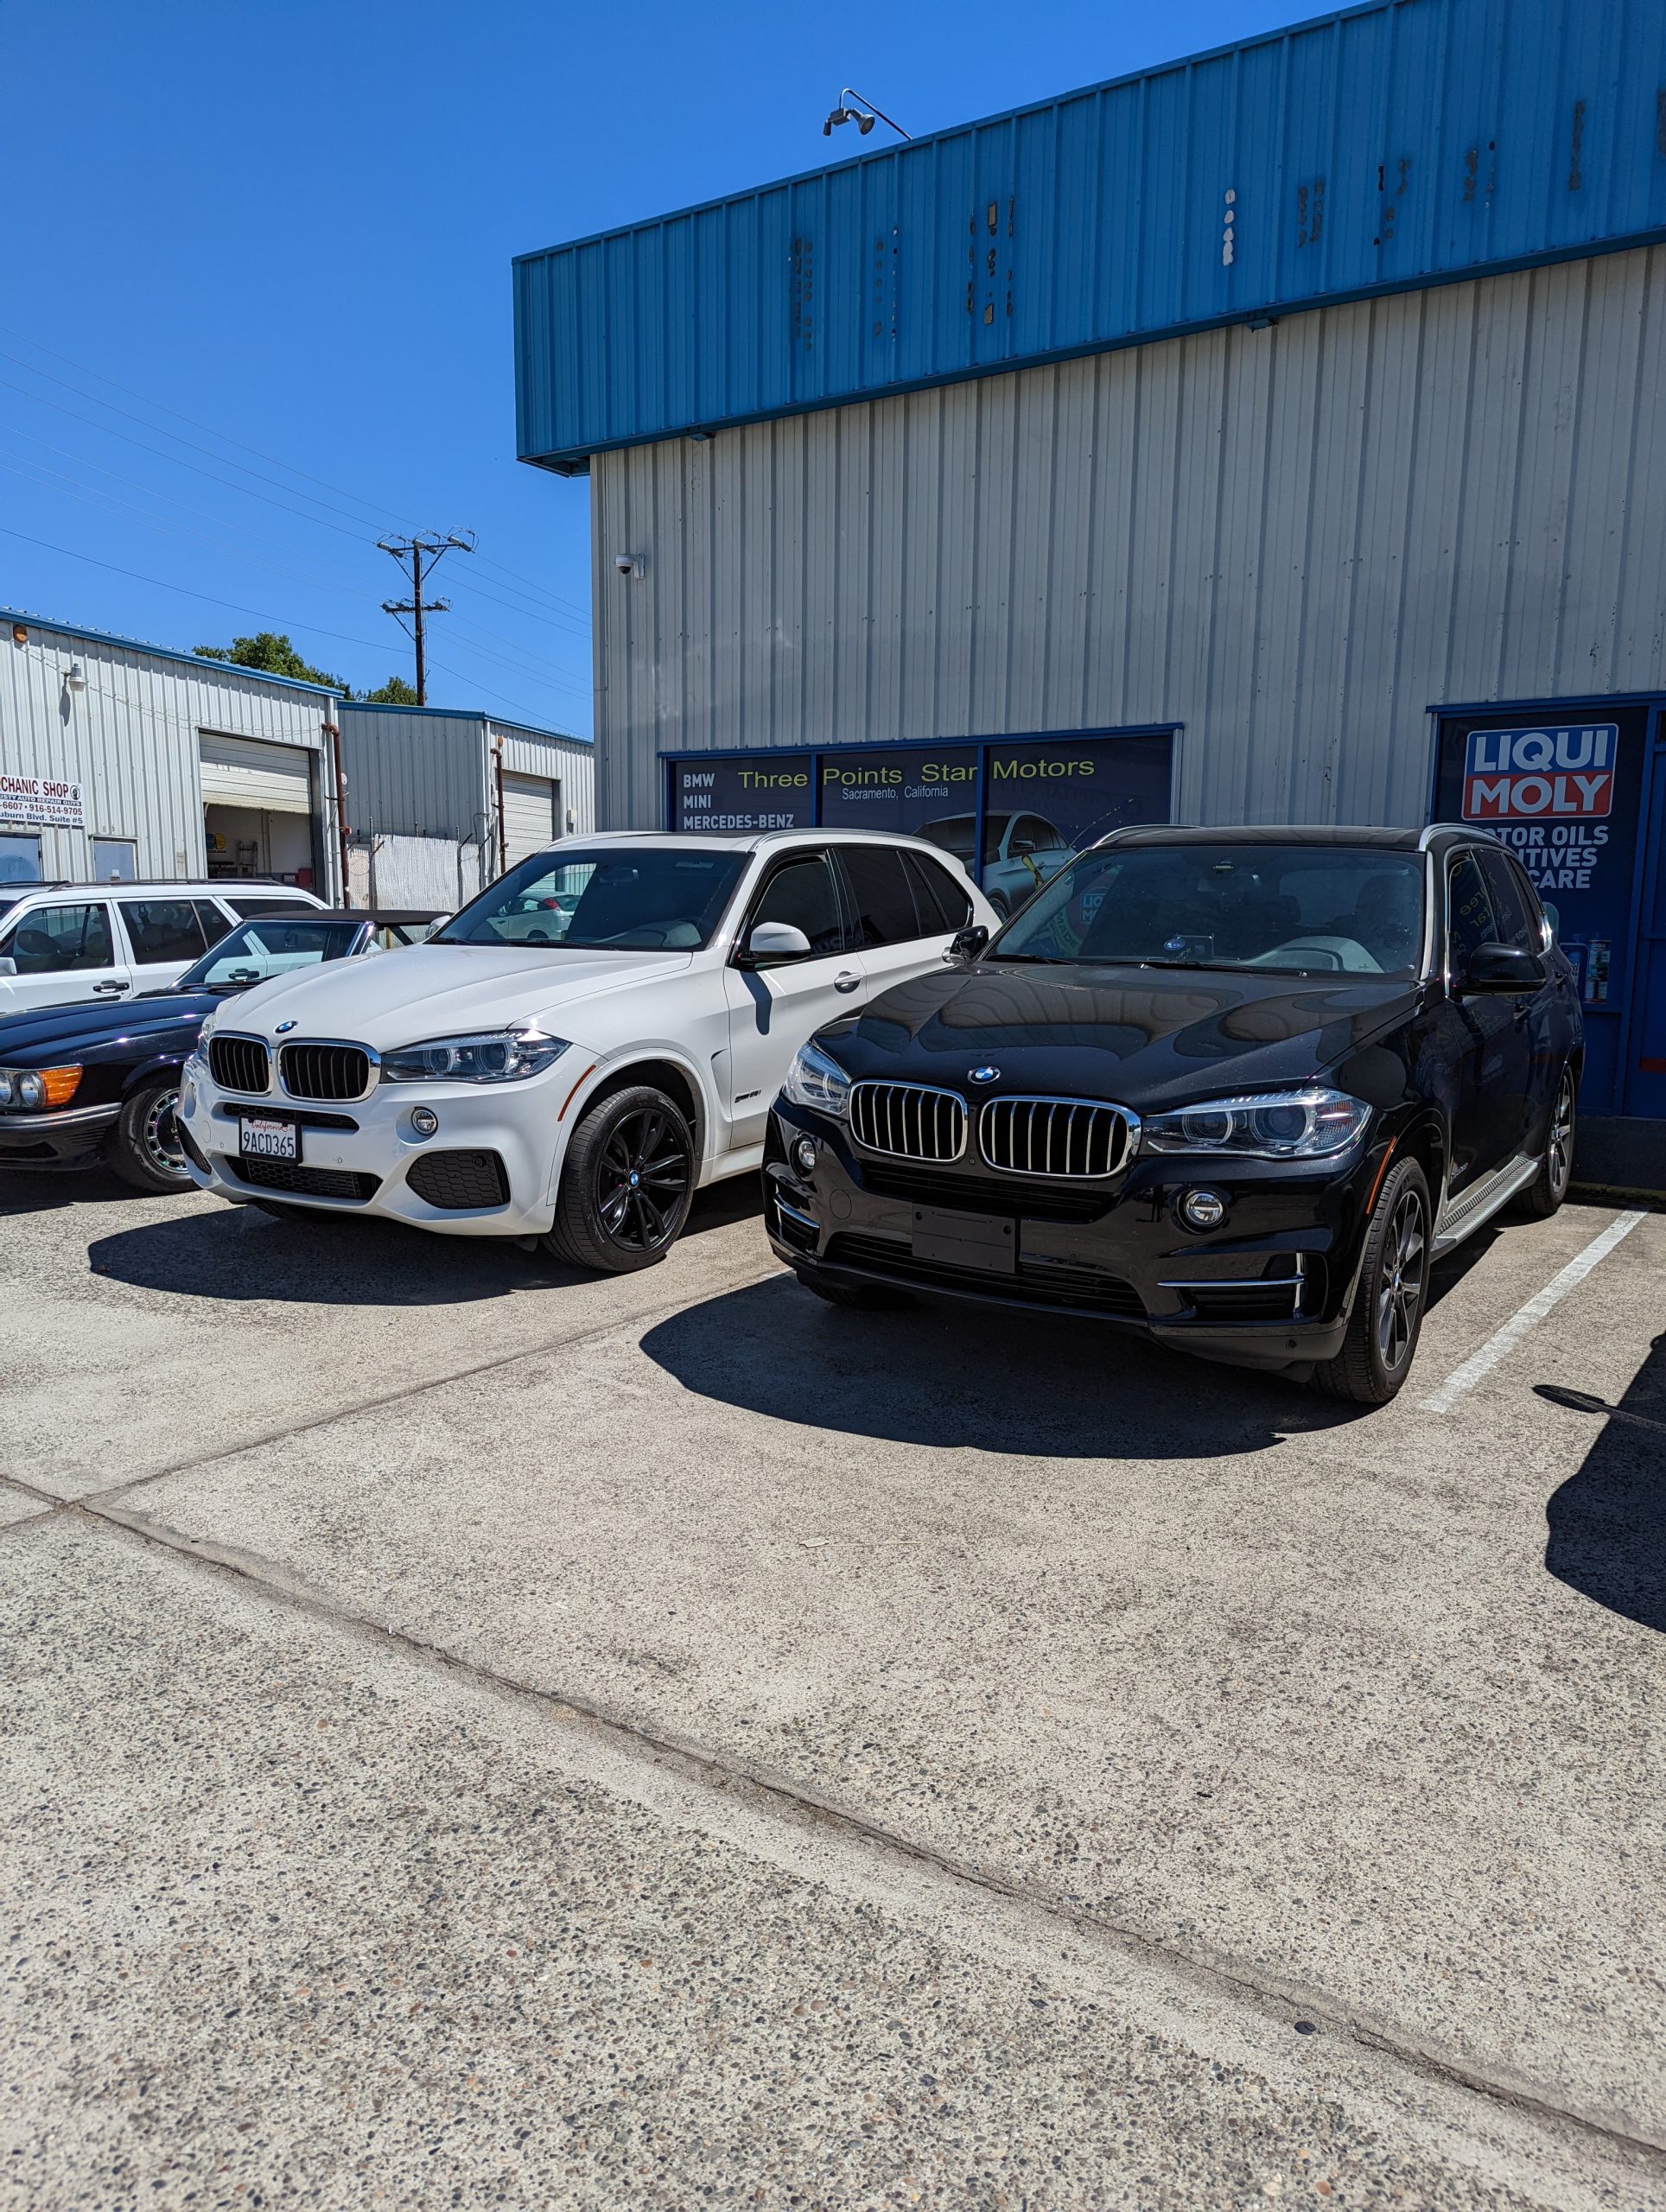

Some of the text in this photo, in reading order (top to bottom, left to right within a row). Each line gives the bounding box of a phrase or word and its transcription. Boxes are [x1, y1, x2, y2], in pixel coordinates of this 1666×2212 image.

[1473, 729, 1609, 772] LIQUI
[683, 772, 715, 788] BMW
[737, 759, 1095, 789] Three Points Star Motors
[0, 776, 69, 798] CHANIC SHOP
[842, 785, 949, 800] Sacramento, California
[1471, 774, 1611, 815] MOLY
[29, 804, 83, 815] 916-514-9705
[683, 794, 712, 809] MINI
[27, 812, 48, 822] Blvd.
[49, 815, 71, 823] Suite
[683, 813, 795, 830] MERCEDES-BENZ
[1485, 825, 1610, 847] TOR OILS
[1517, 847, 1599, 868] ITIVES
[243, 1131, 295, 1157] 9ACD365
